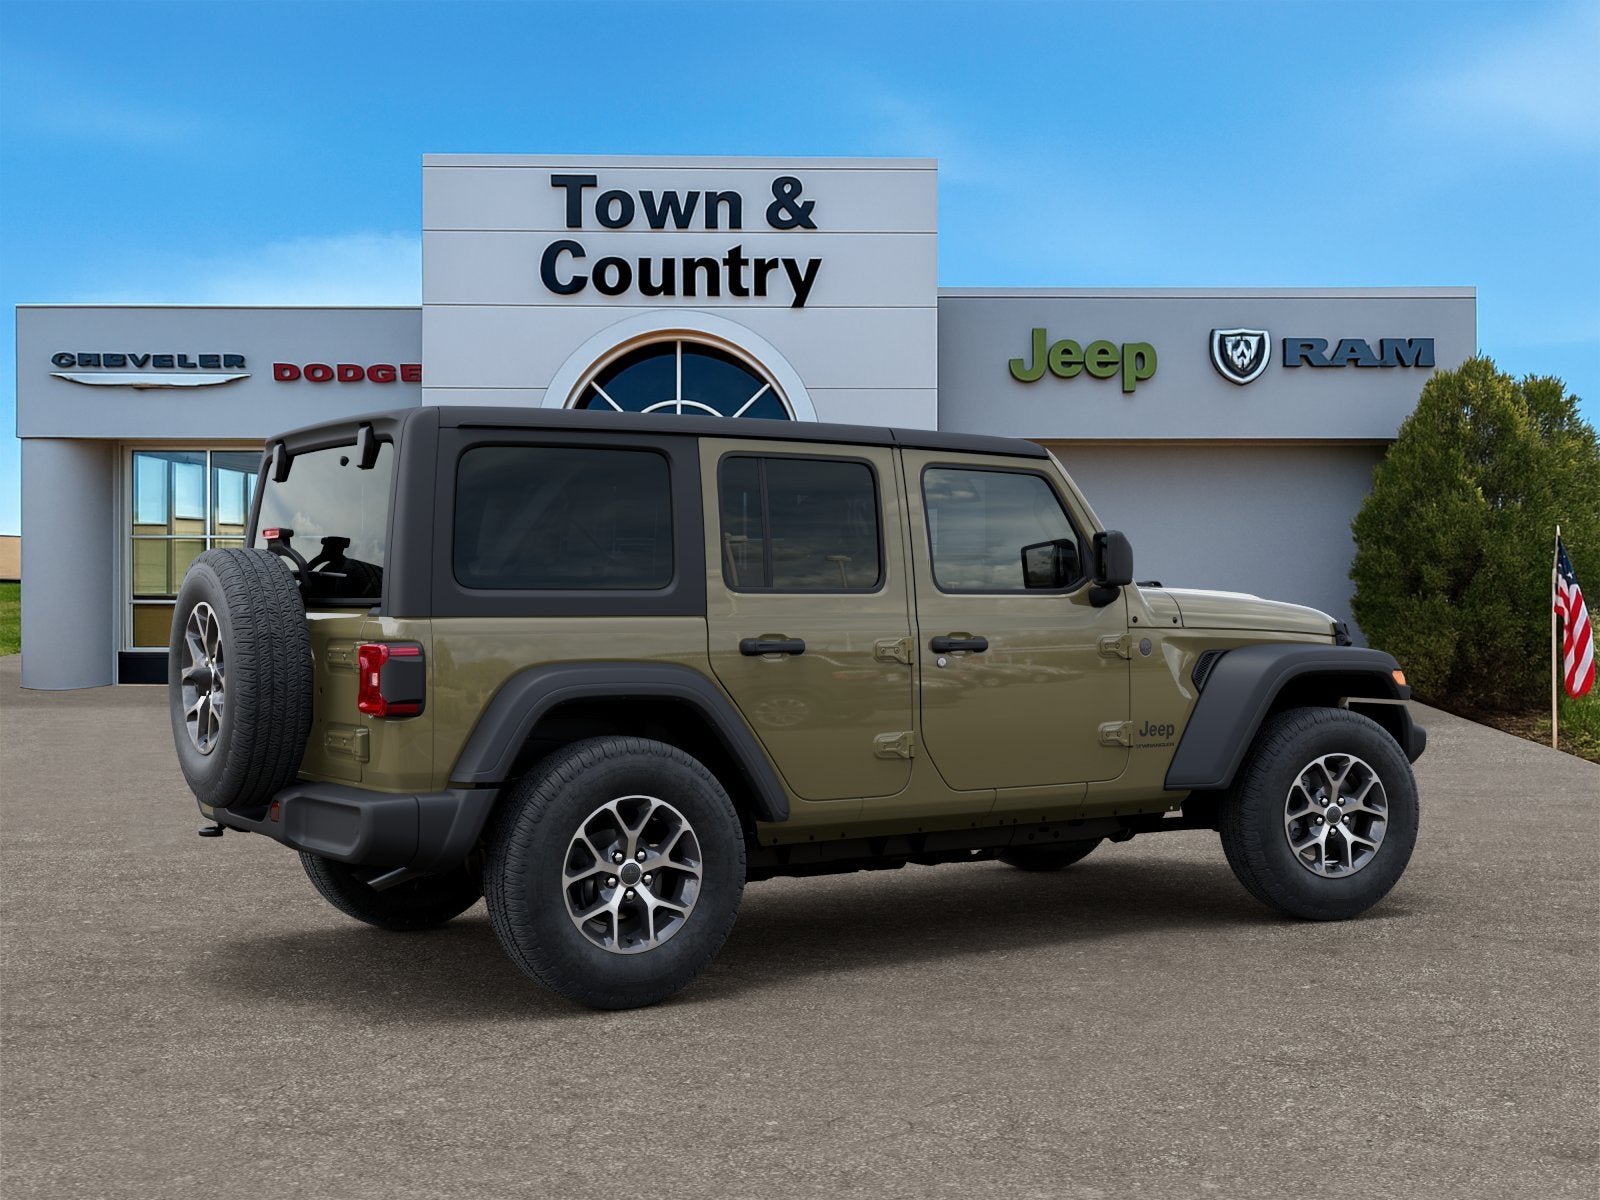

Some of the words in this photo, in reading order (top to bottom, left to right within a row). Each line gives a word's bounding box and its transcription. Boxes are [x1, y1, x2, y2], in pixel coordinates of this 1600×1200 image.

[550, 174, 743, 229] Town
[765, 176, 818, 230] &
[540, 239, 822, 308] Country
[273, 362, 422, 383] DODGE
[1009, 328, 1157, 392] Jeep
[1282, 338, 1436, 368] RAM
[1139, 720, 1175, 739] Jeep
